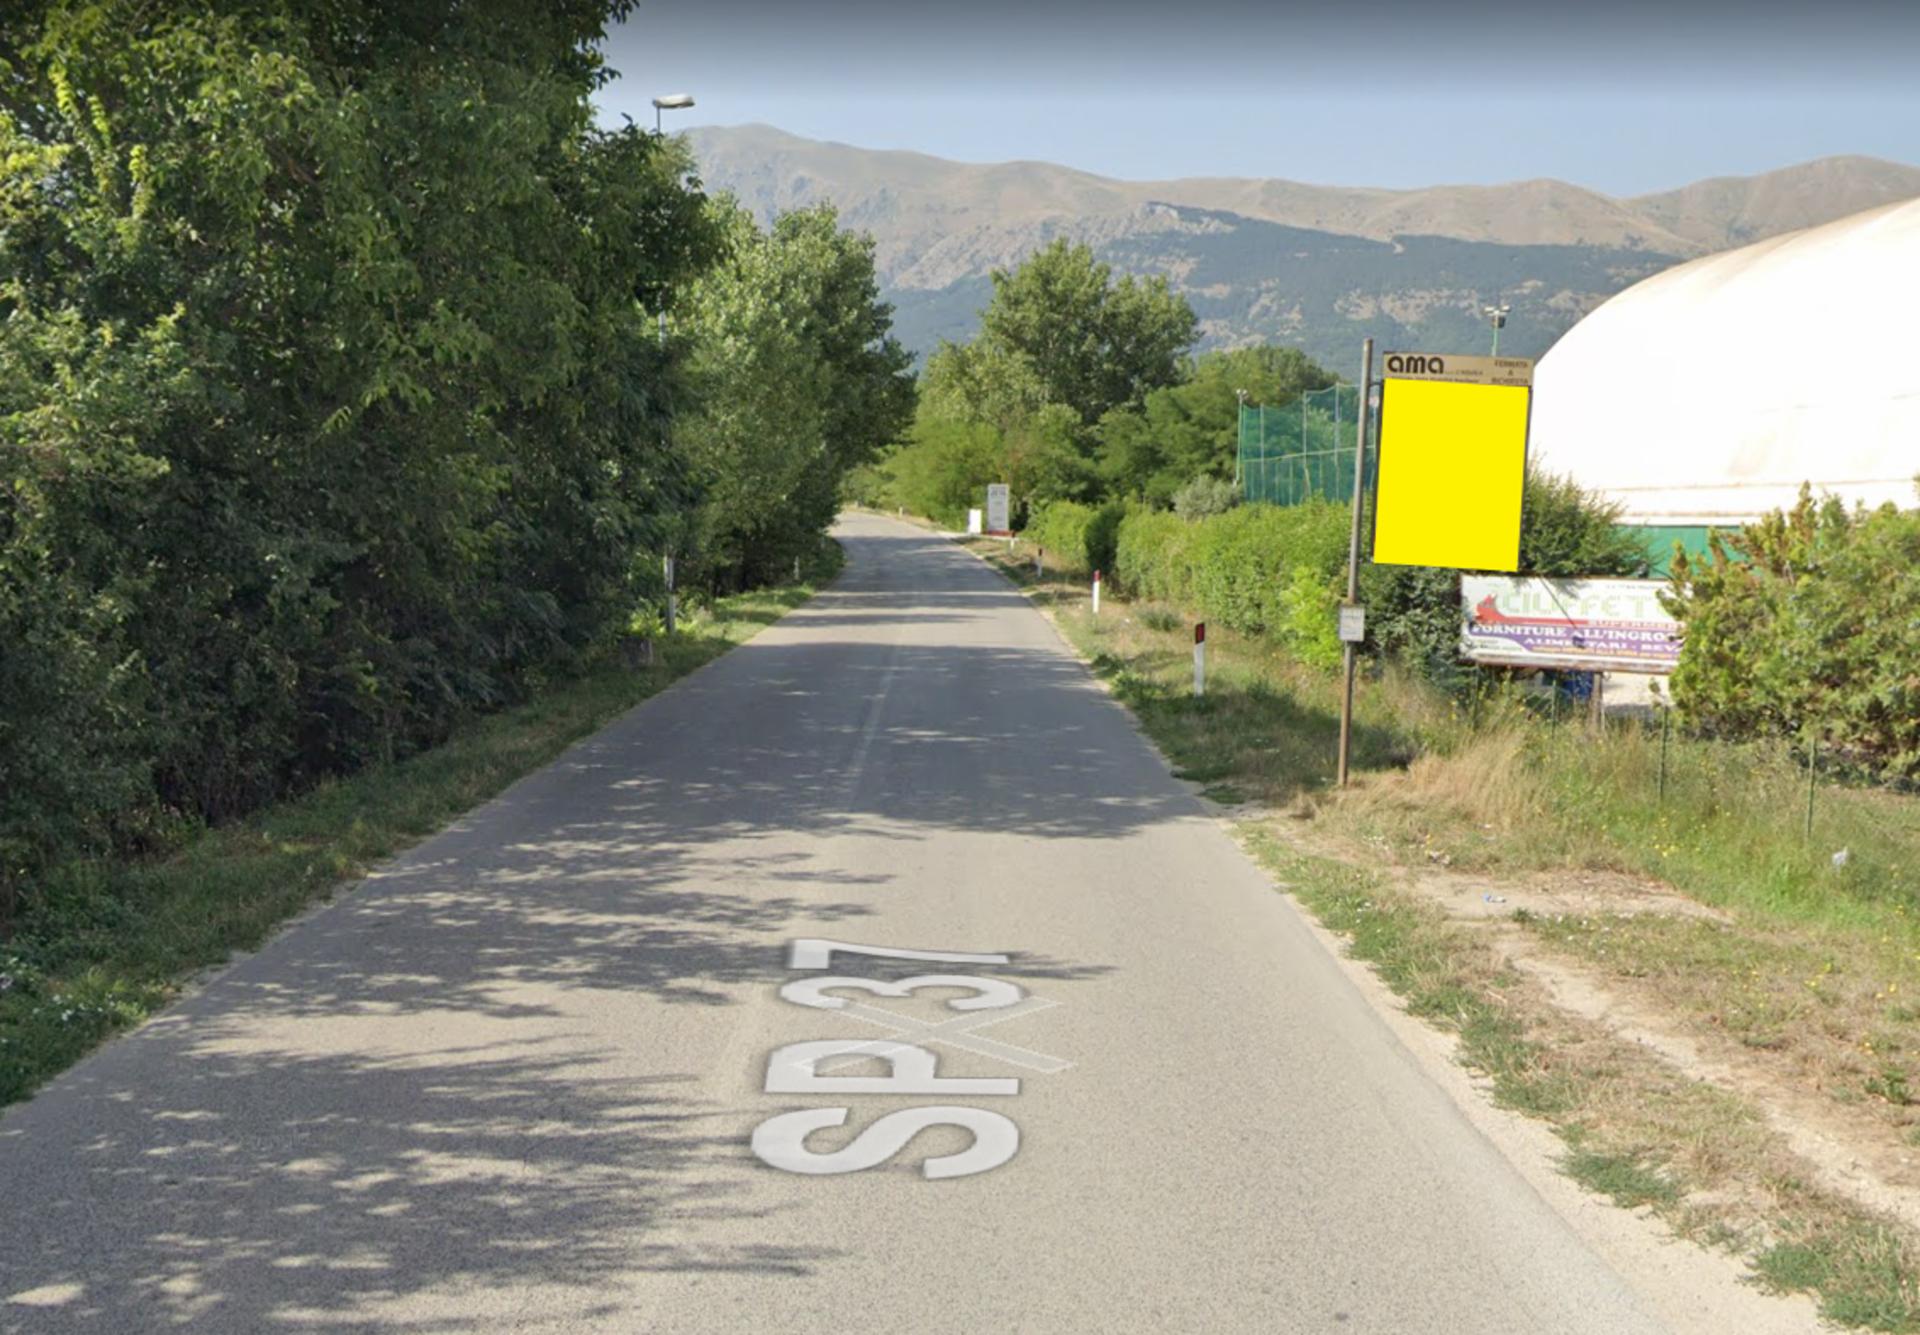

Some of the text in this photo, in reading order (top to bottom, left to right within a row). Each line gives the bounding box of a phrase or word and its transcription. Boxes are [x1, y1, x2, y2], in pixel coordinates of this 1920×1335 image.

[1387, 356, 1444, 374] ama
[1571, 628, 1678, 643] ALL'INGRO
[1524, 637, 1628, 651] ALIMETARI
